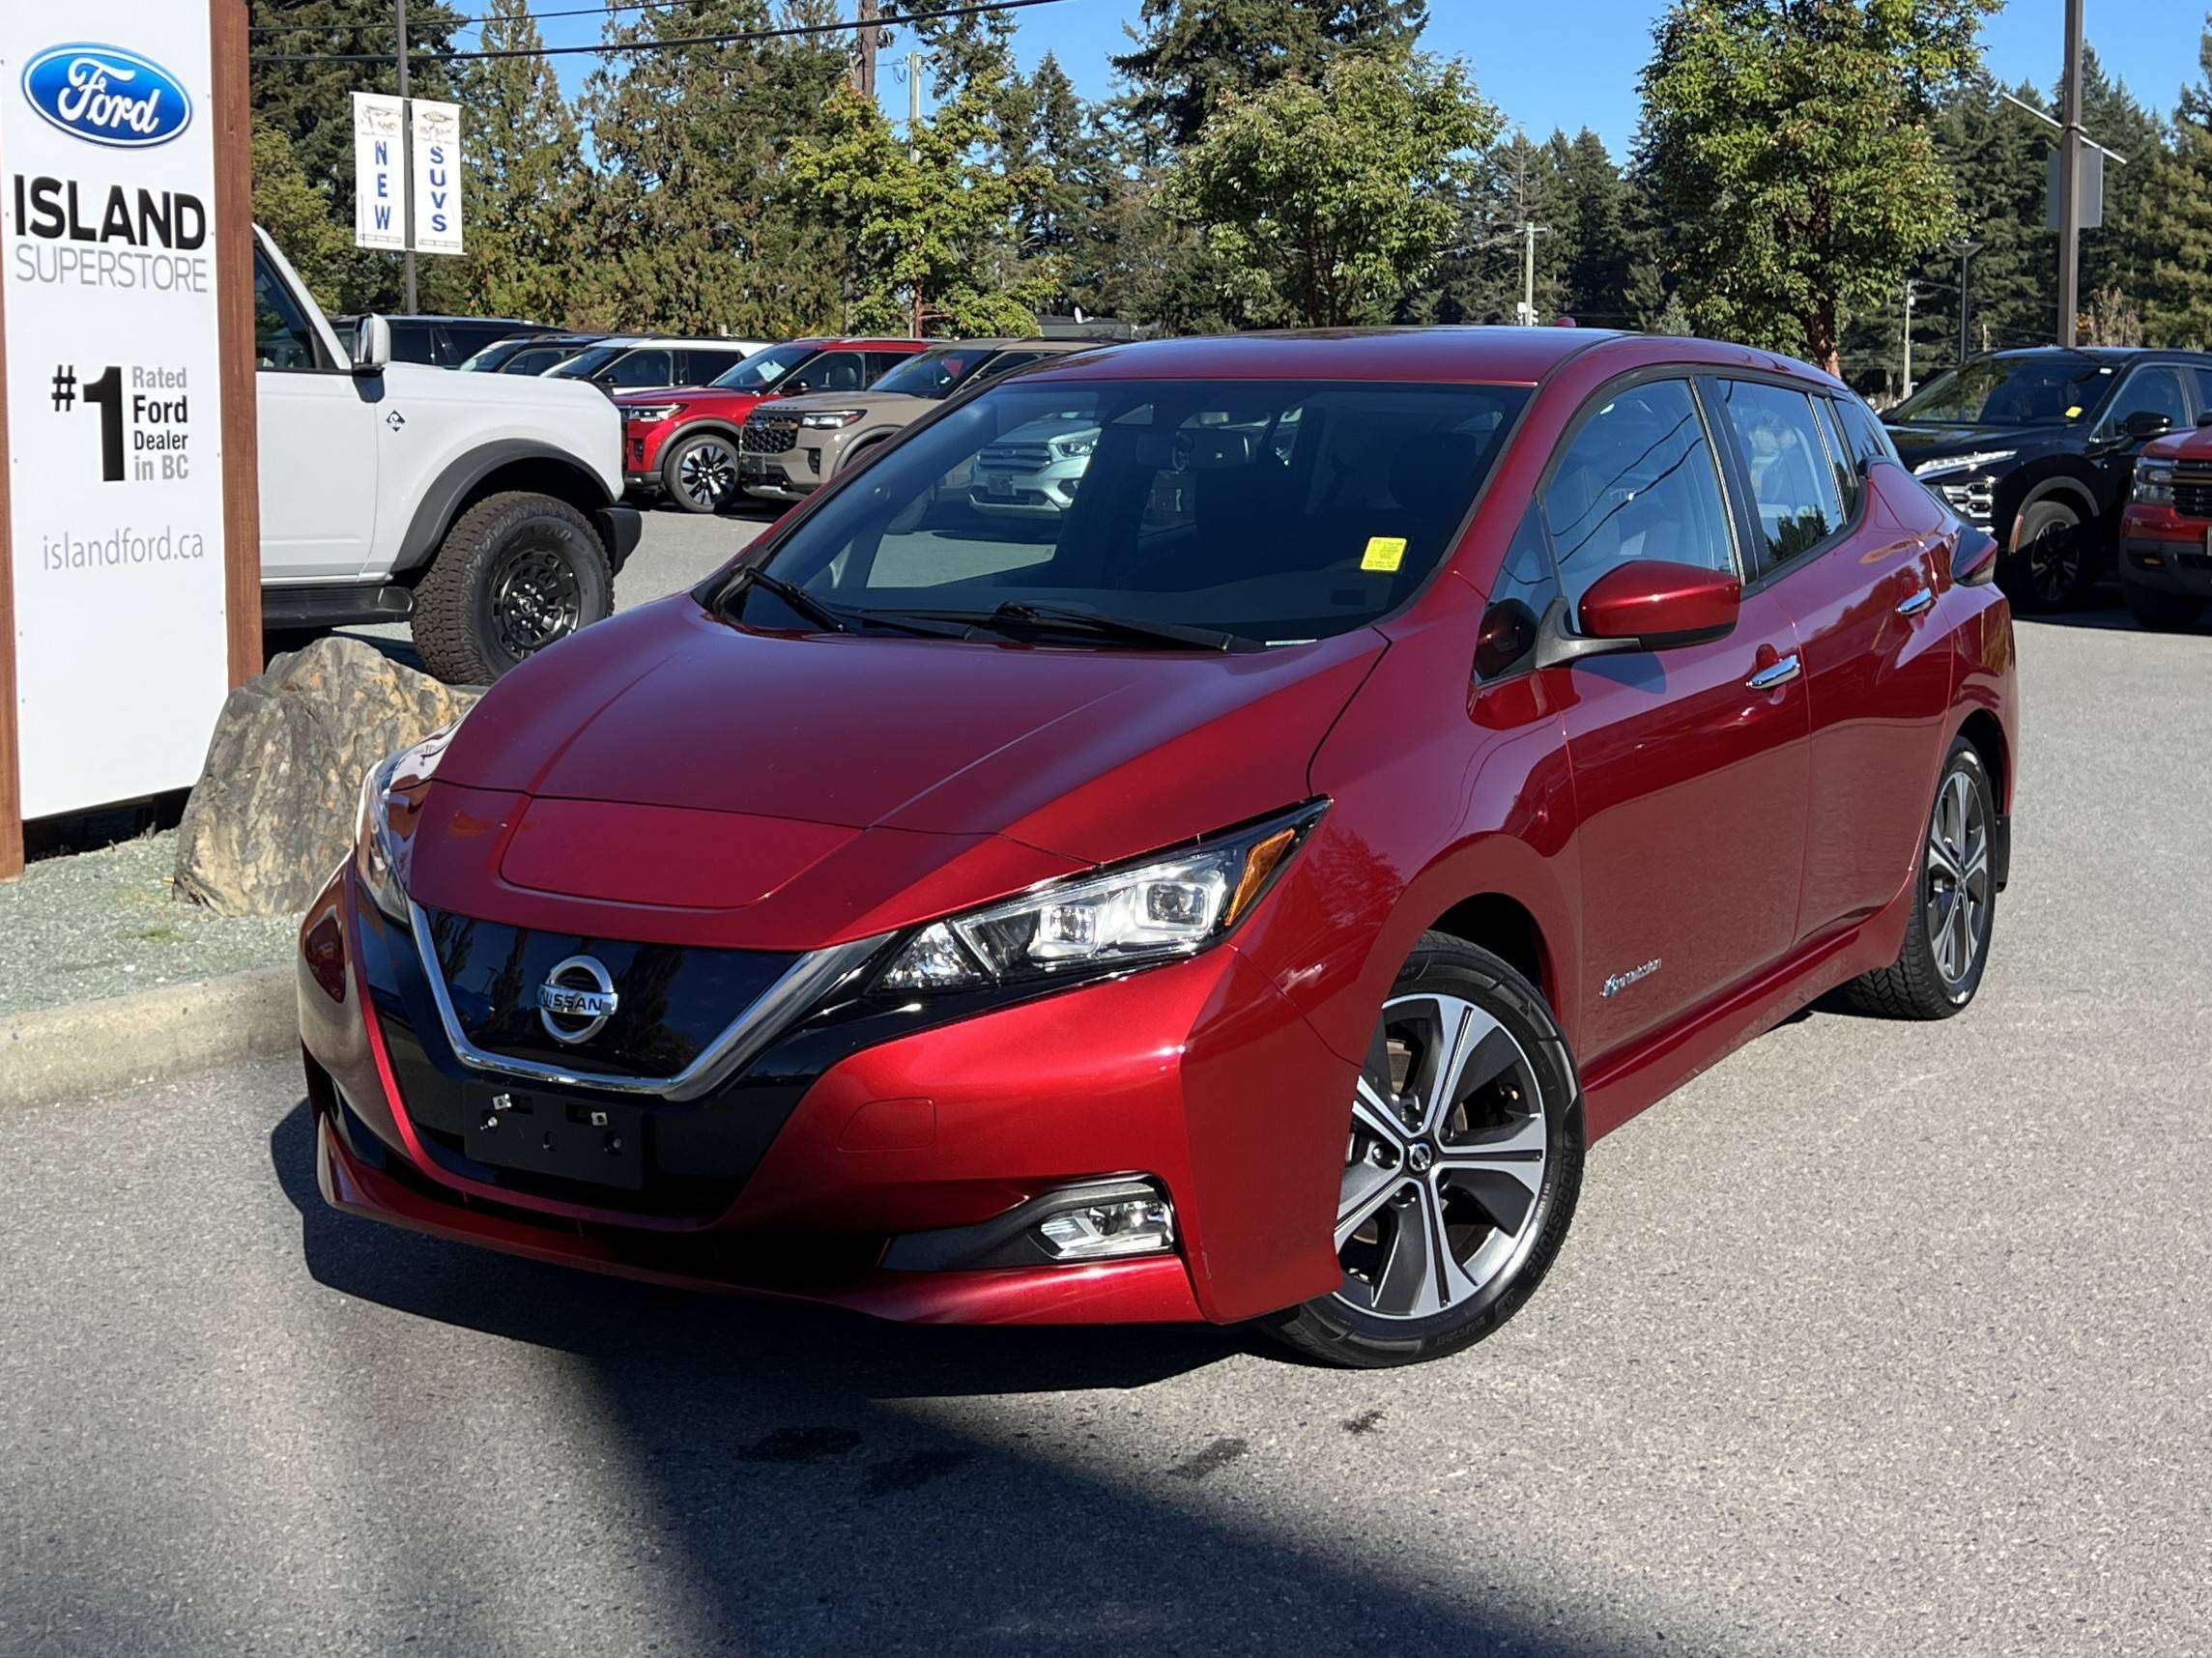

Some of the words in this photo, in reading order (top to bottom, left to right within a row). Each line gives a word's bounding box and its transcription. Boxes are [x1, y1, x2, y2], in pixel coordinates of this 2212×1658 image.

[58, 57, 161, 133] Ford
[375, 140, 391, 231] NEW
[429, 145, 448, 233] SUVS
[14, 174, 207, 251] ISLAND
[15, 243, 208, 293] SUPERSTORE
[132, 365, 187, 388] Rated
[133, 394, 188, 423] Ford
[133, 430, 188, 450] Dealer
[134, 455, 155, 481] in
[162, 454, 189, 480] BC
[43, 525, 204, 570] islandford.ca
[540, 988, 603, 1011] NISSAN
